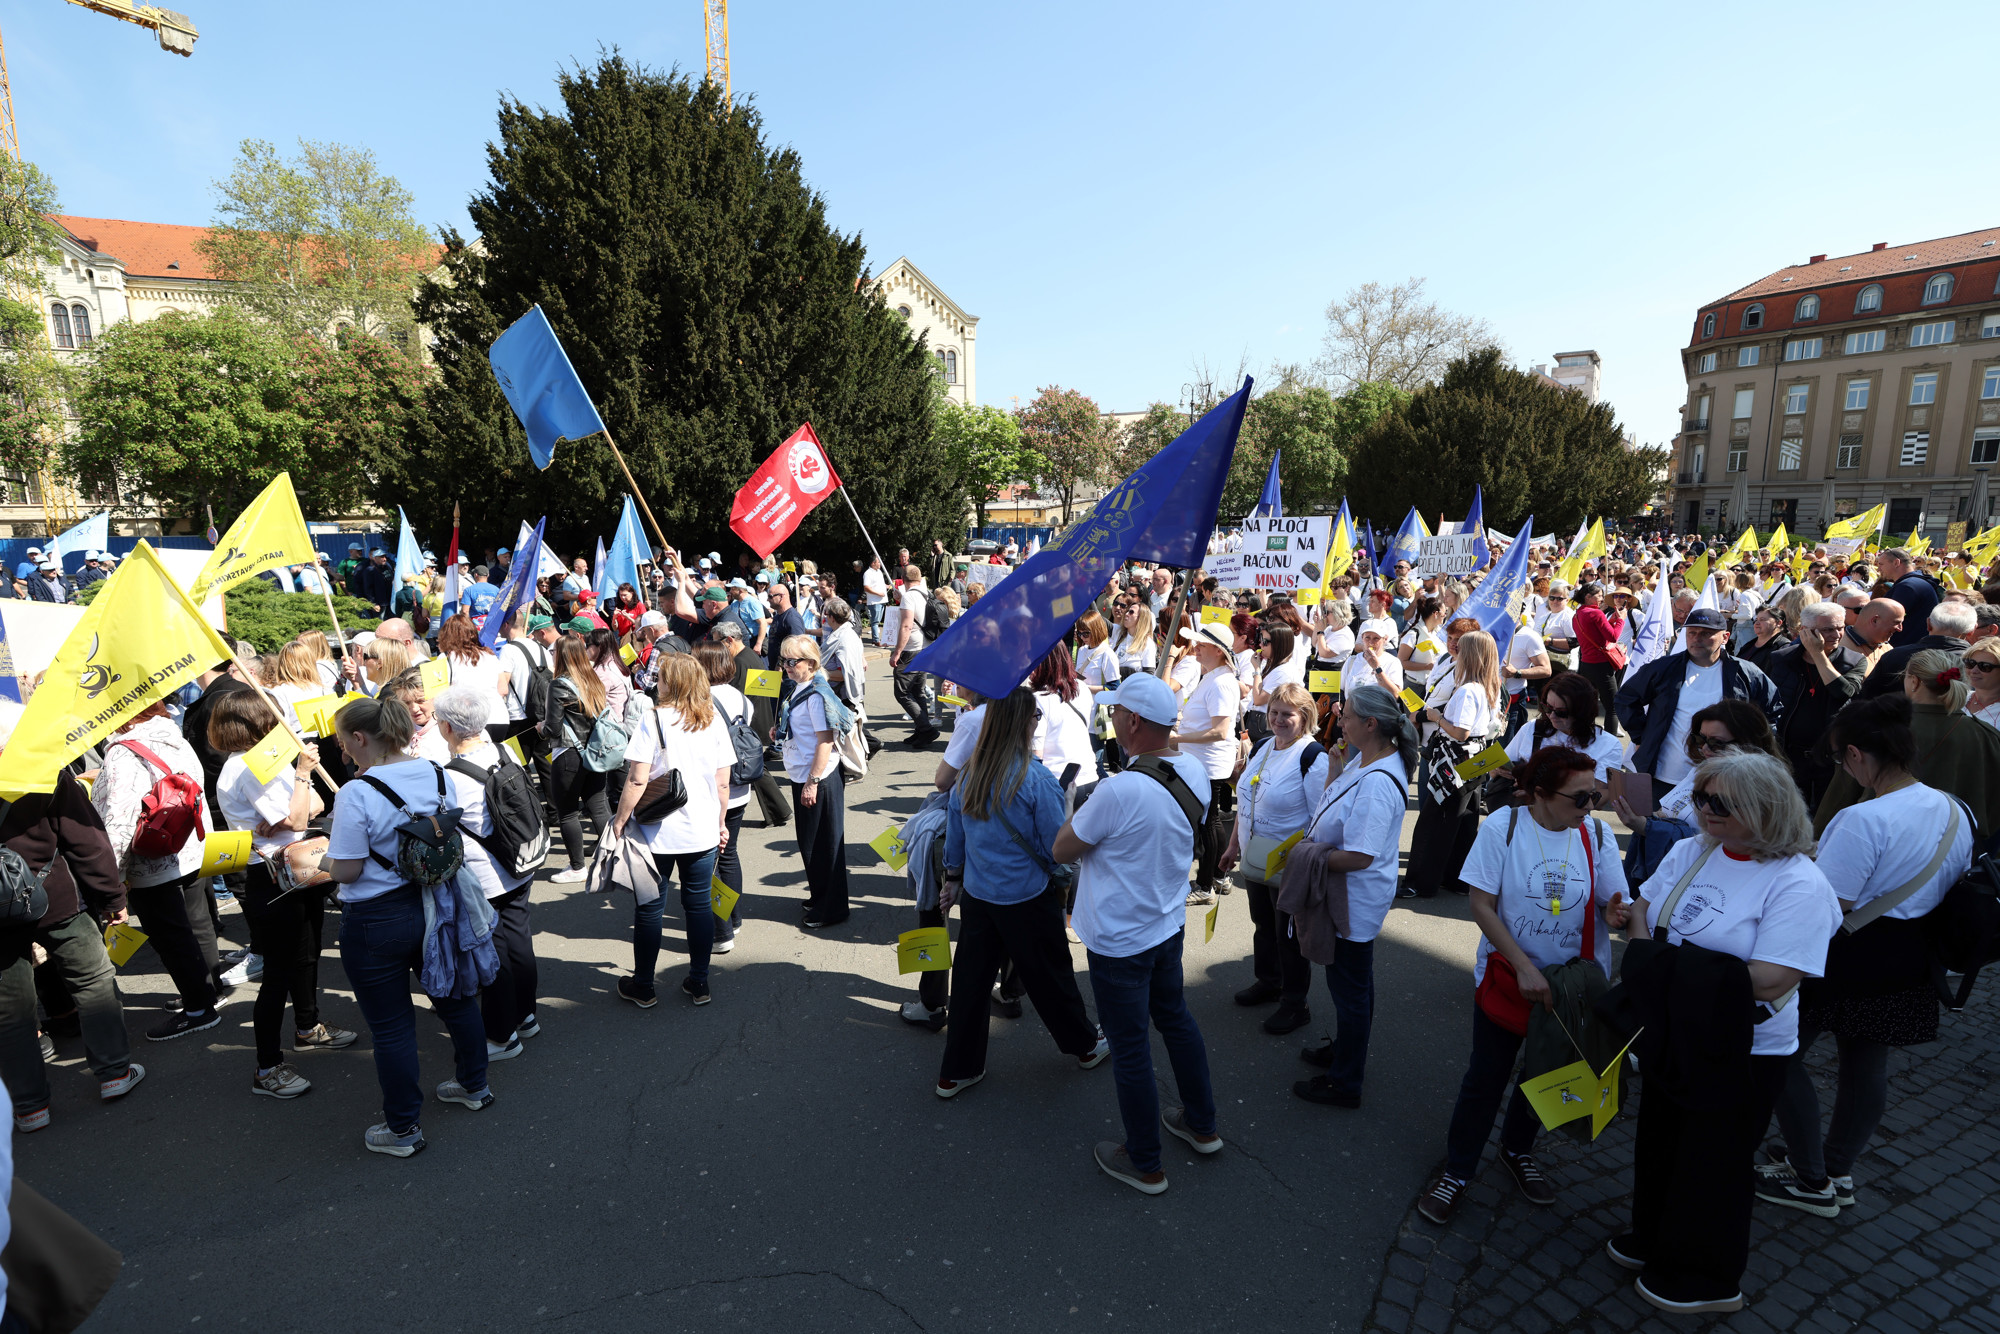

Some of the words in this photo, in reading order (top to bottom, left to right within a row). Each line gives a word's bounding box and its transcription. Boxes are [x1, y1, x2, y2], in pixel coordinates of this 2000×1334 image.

[1245, 519, 1261, 532] NA
[1268, 517, 1309, 533] PLOČI
[1297, 537, 1315, 551] NA
[1420, 538, 1455, 556] INFLACIJA
[1462, 537, 1473, 554] MI
[1243, 553, 1292, 569] RAČUNU
[1417, 557, 1442, 574] POJELA
[1255, 573, 1300, 588] MINUS!
[1514, 915, 1562, 942] Nikada
